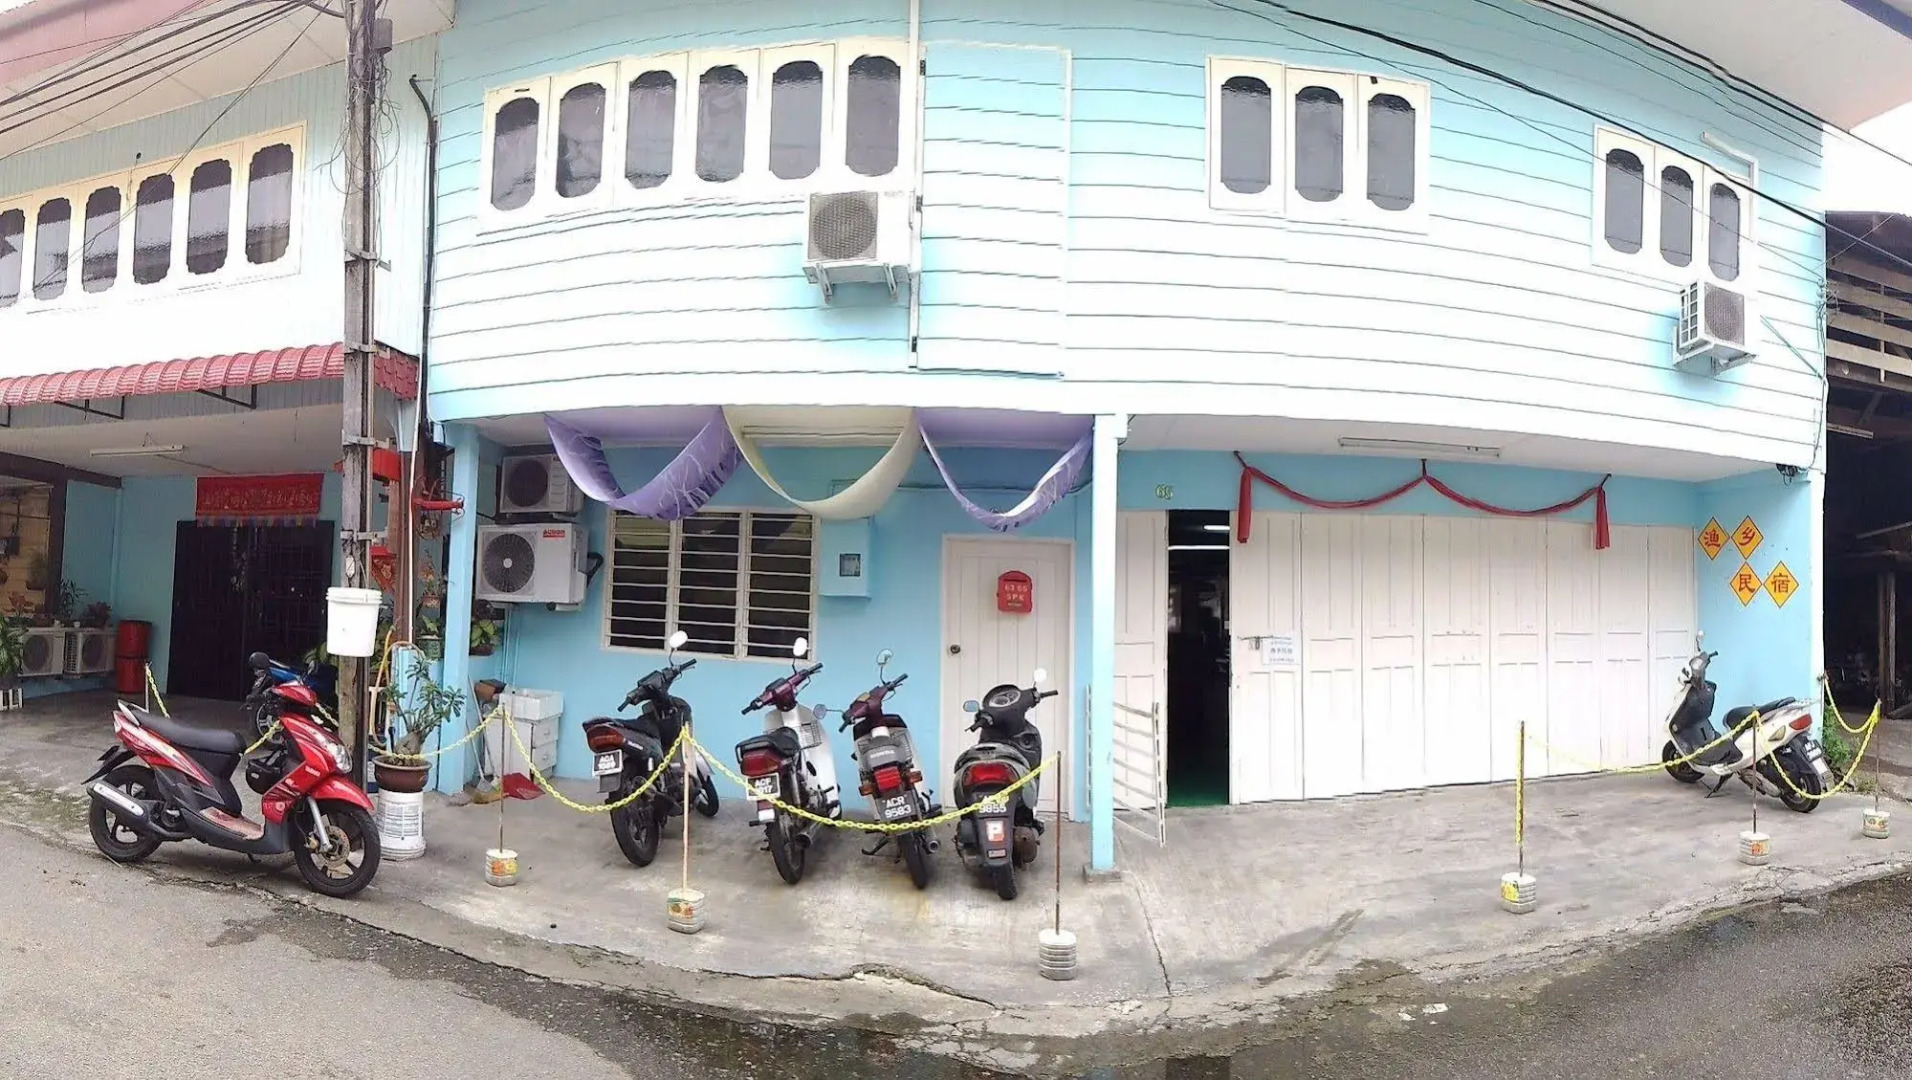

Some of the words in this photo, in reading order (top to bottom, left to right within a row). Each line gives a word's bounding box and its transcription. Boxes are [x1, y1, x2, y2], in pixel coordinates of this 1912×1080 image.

[1738, 573, 1790, 593] 民宿
[884, 805, 912, 819] 9583
[979, 803, 1007, 813] 9855
